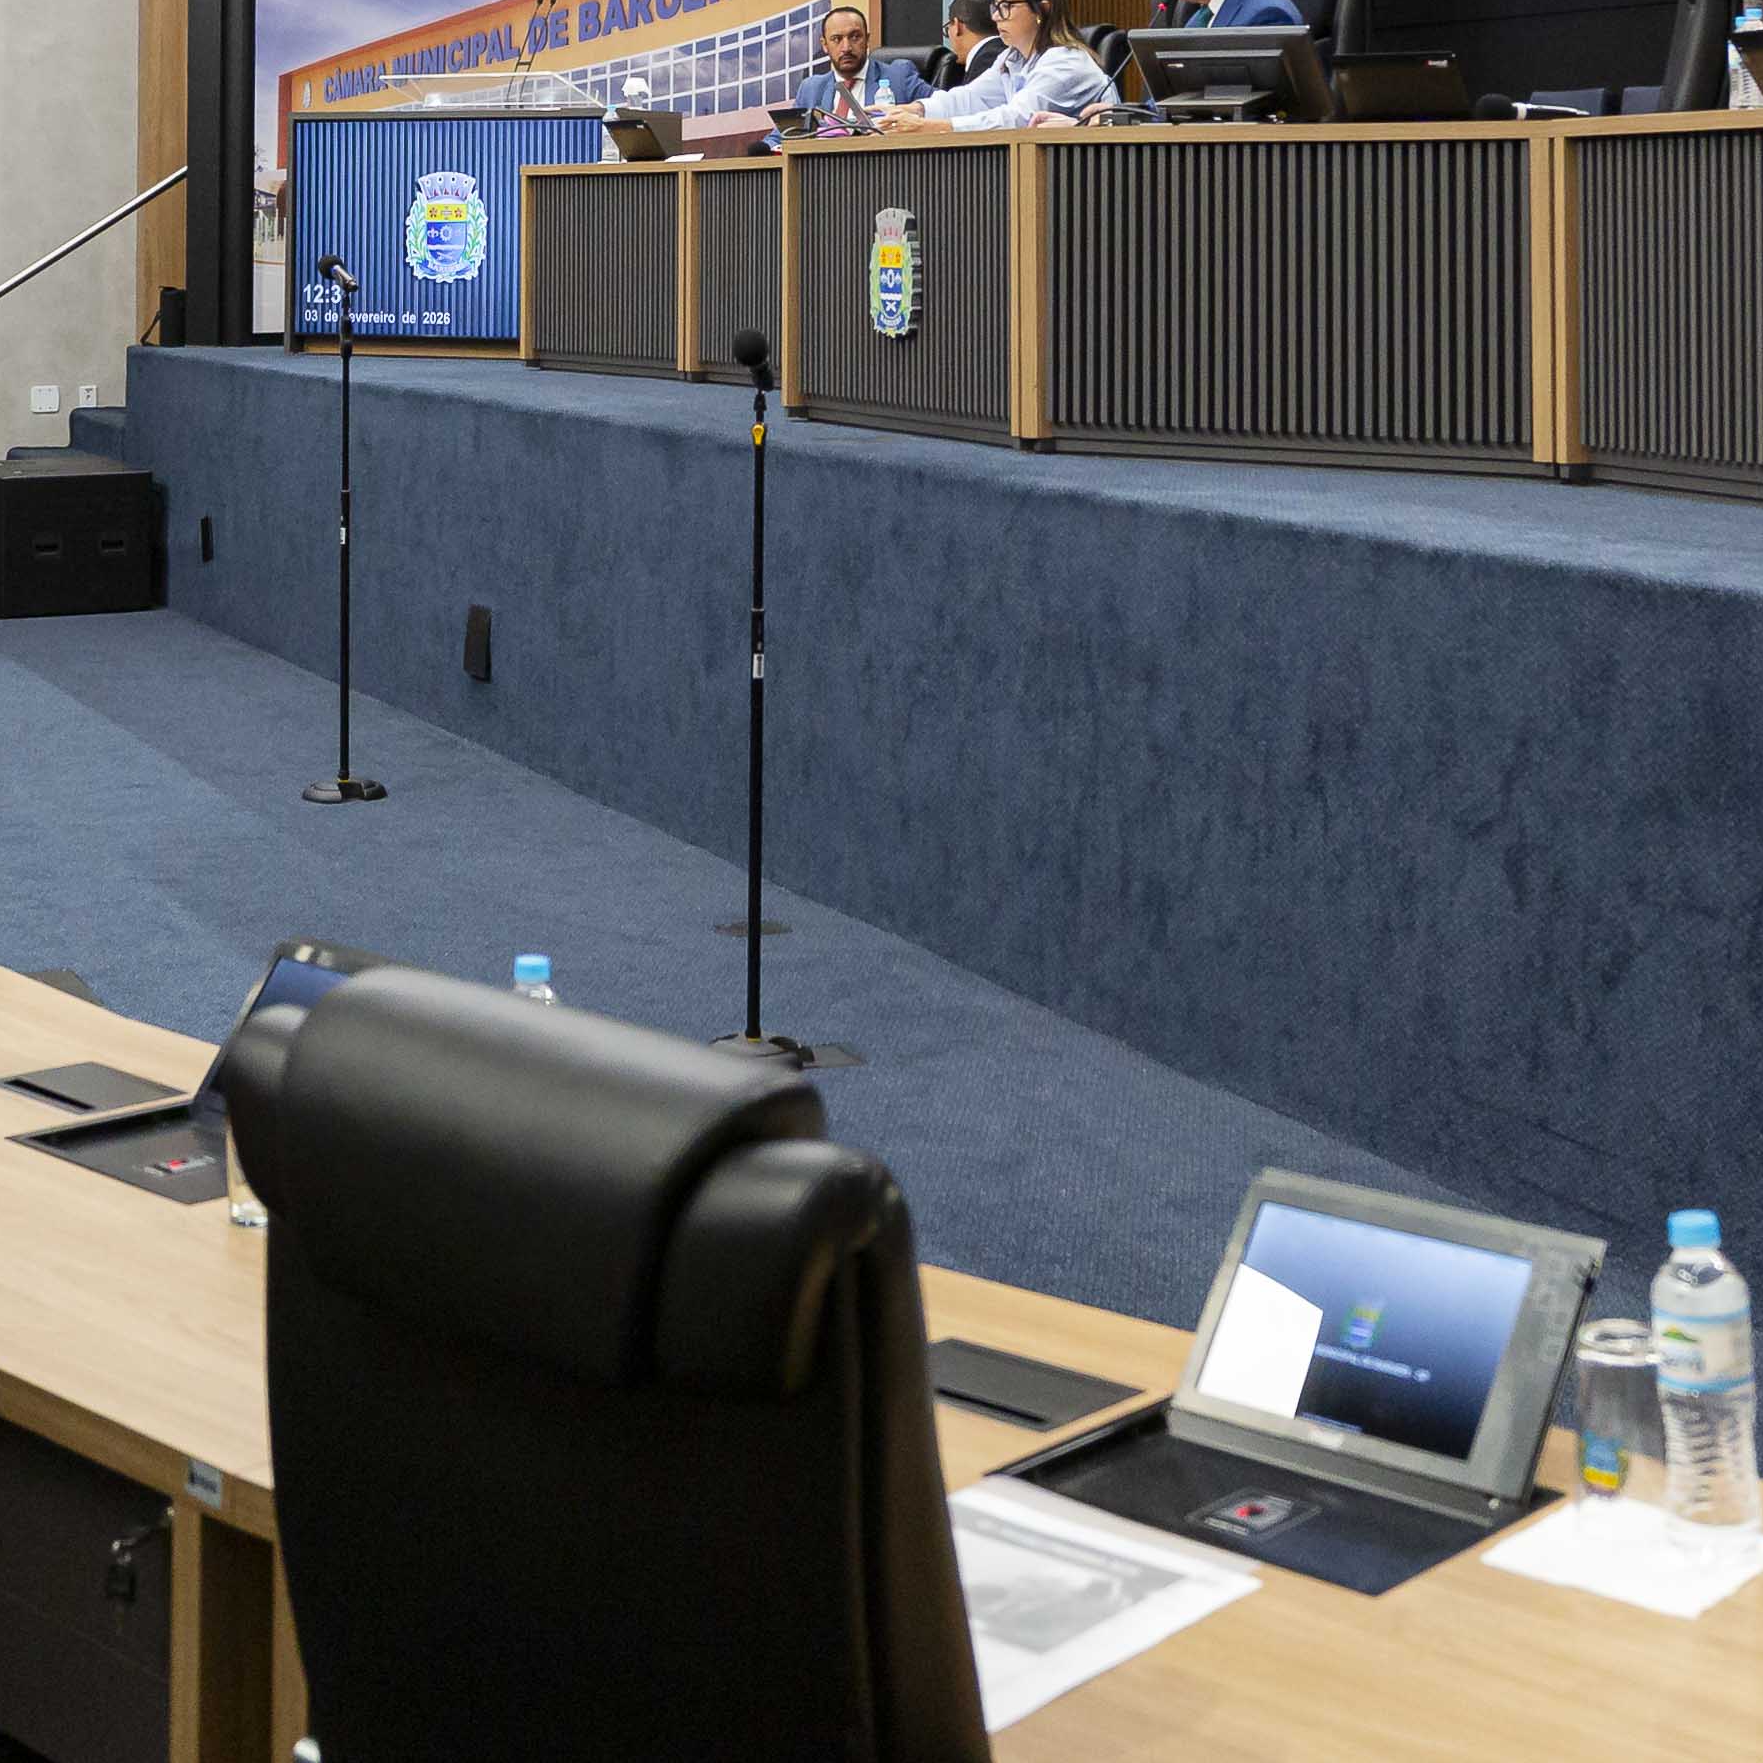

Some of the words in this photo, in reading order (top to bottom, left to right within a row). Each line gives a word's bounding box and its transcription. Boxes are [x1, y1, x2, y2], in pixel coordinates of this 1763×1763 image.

[323, 62, 388, 104] CÂMARA
[392, 23, 521, 90] MUNICIPAL
[527, 8, 569, 55] DE
[303, 284, 342, 304] 12:3
[304, 309, 318, 322] 03
[324, 309, 338, 323] de
[348, 310, 395, 324] evereiro
[402, 311, 416, 324] de
[422, 312, 451, 325] 2026
